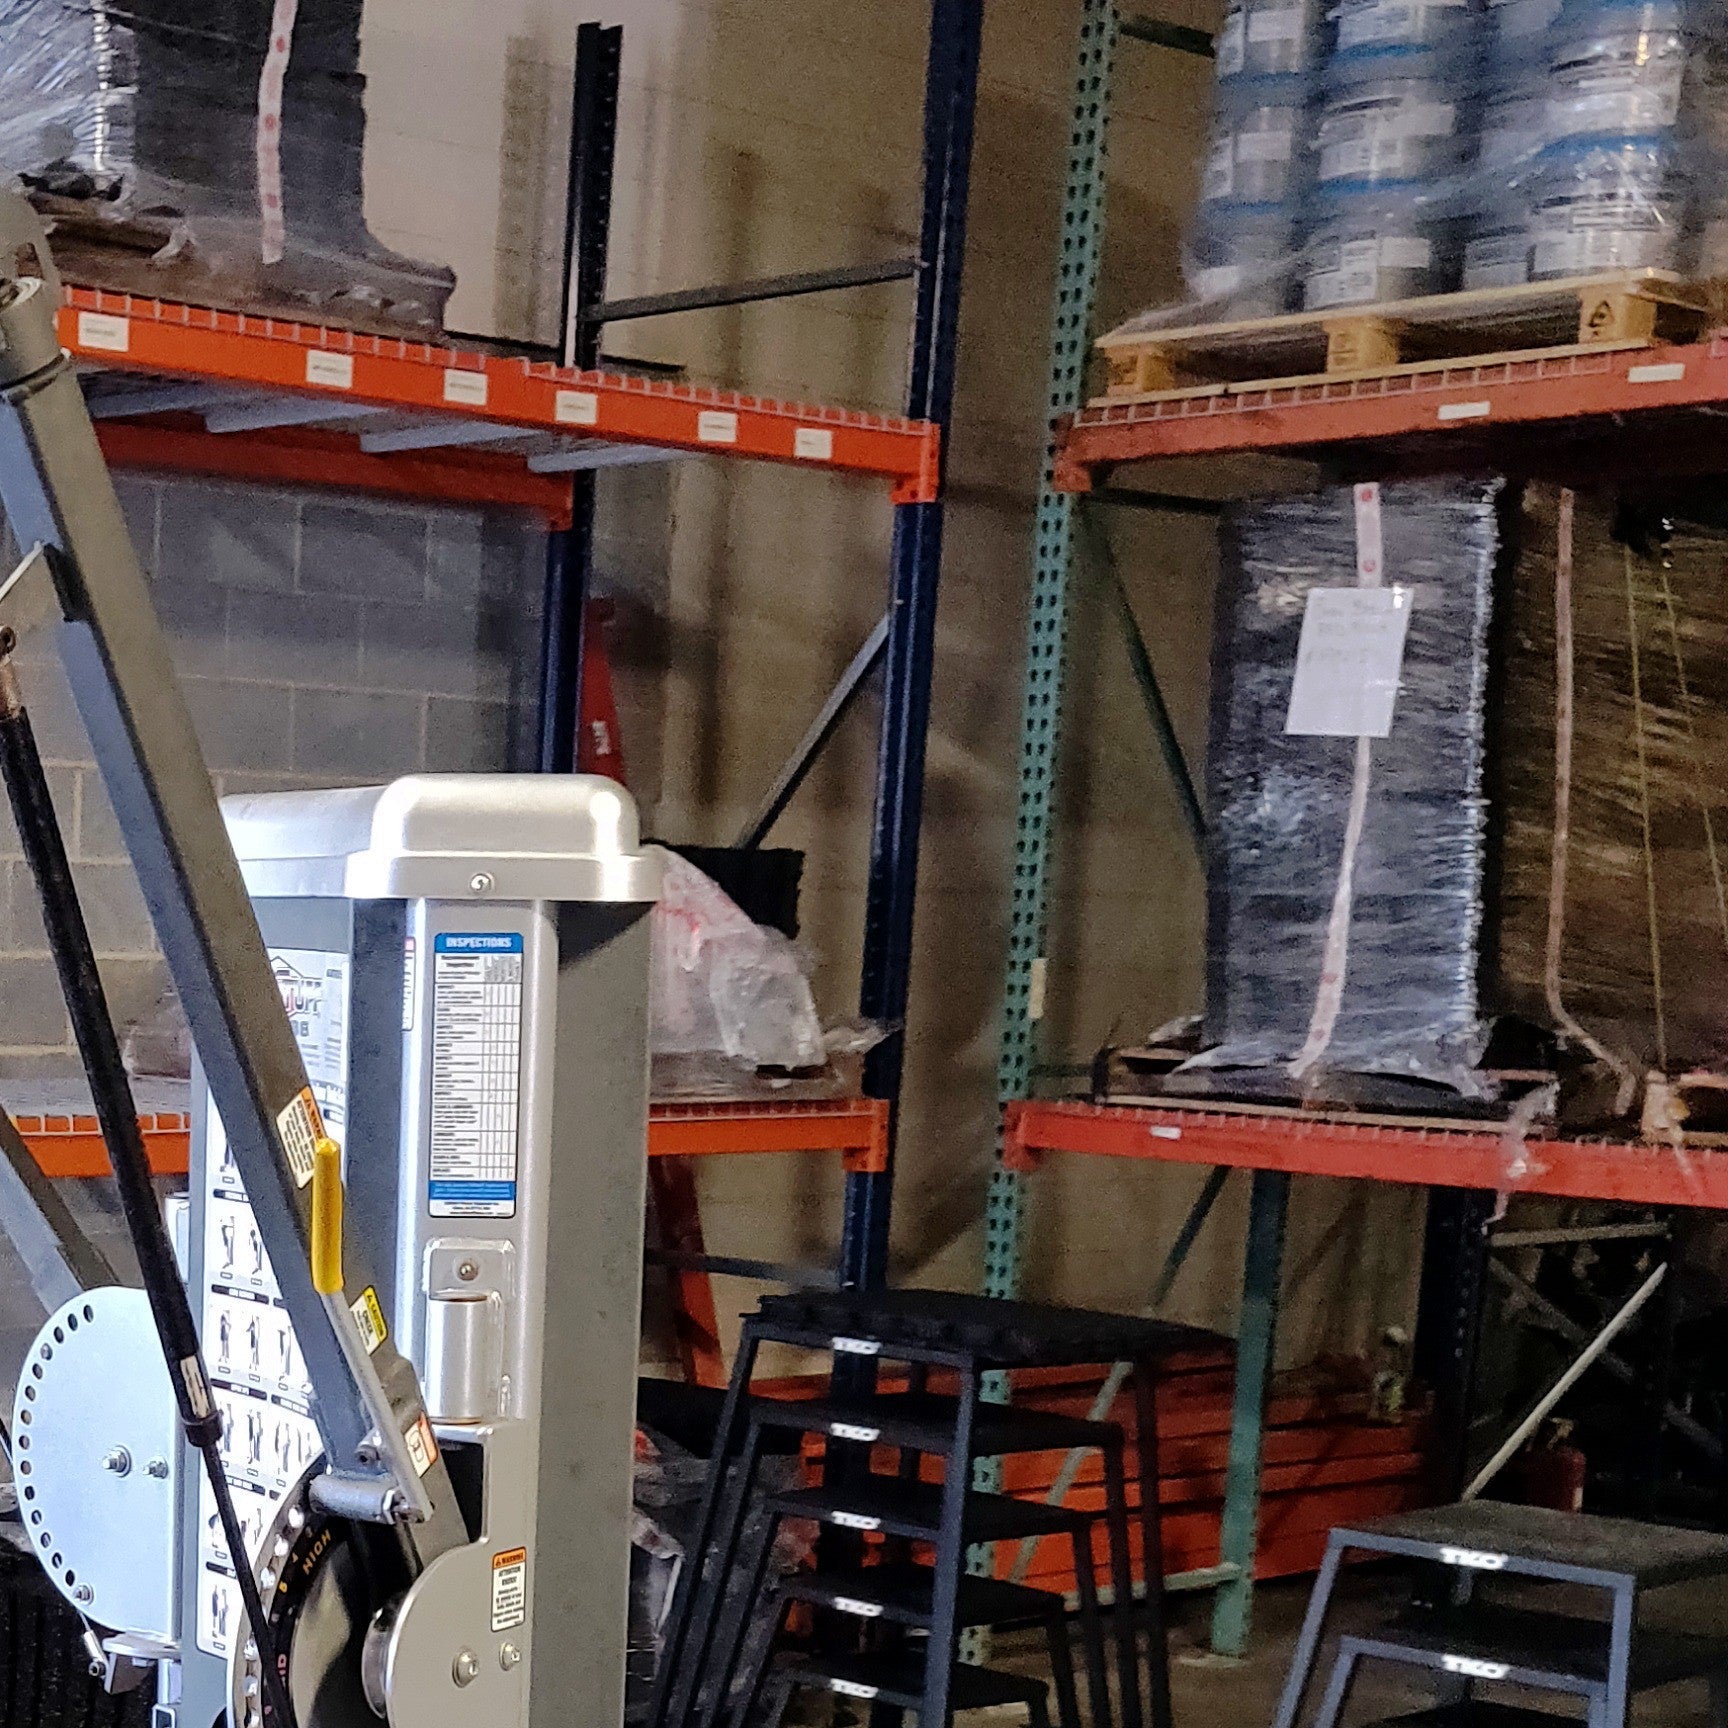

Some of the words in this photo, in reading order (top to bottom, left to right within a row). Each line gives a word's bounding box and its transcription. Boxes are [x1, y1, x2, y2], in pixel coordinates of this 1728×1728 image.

[445, 936, 512, 949] INSPECTIONS
[1439, 1546, 1508, 1571] TKO
[1441, 1652, 1511, 1680] TKO
